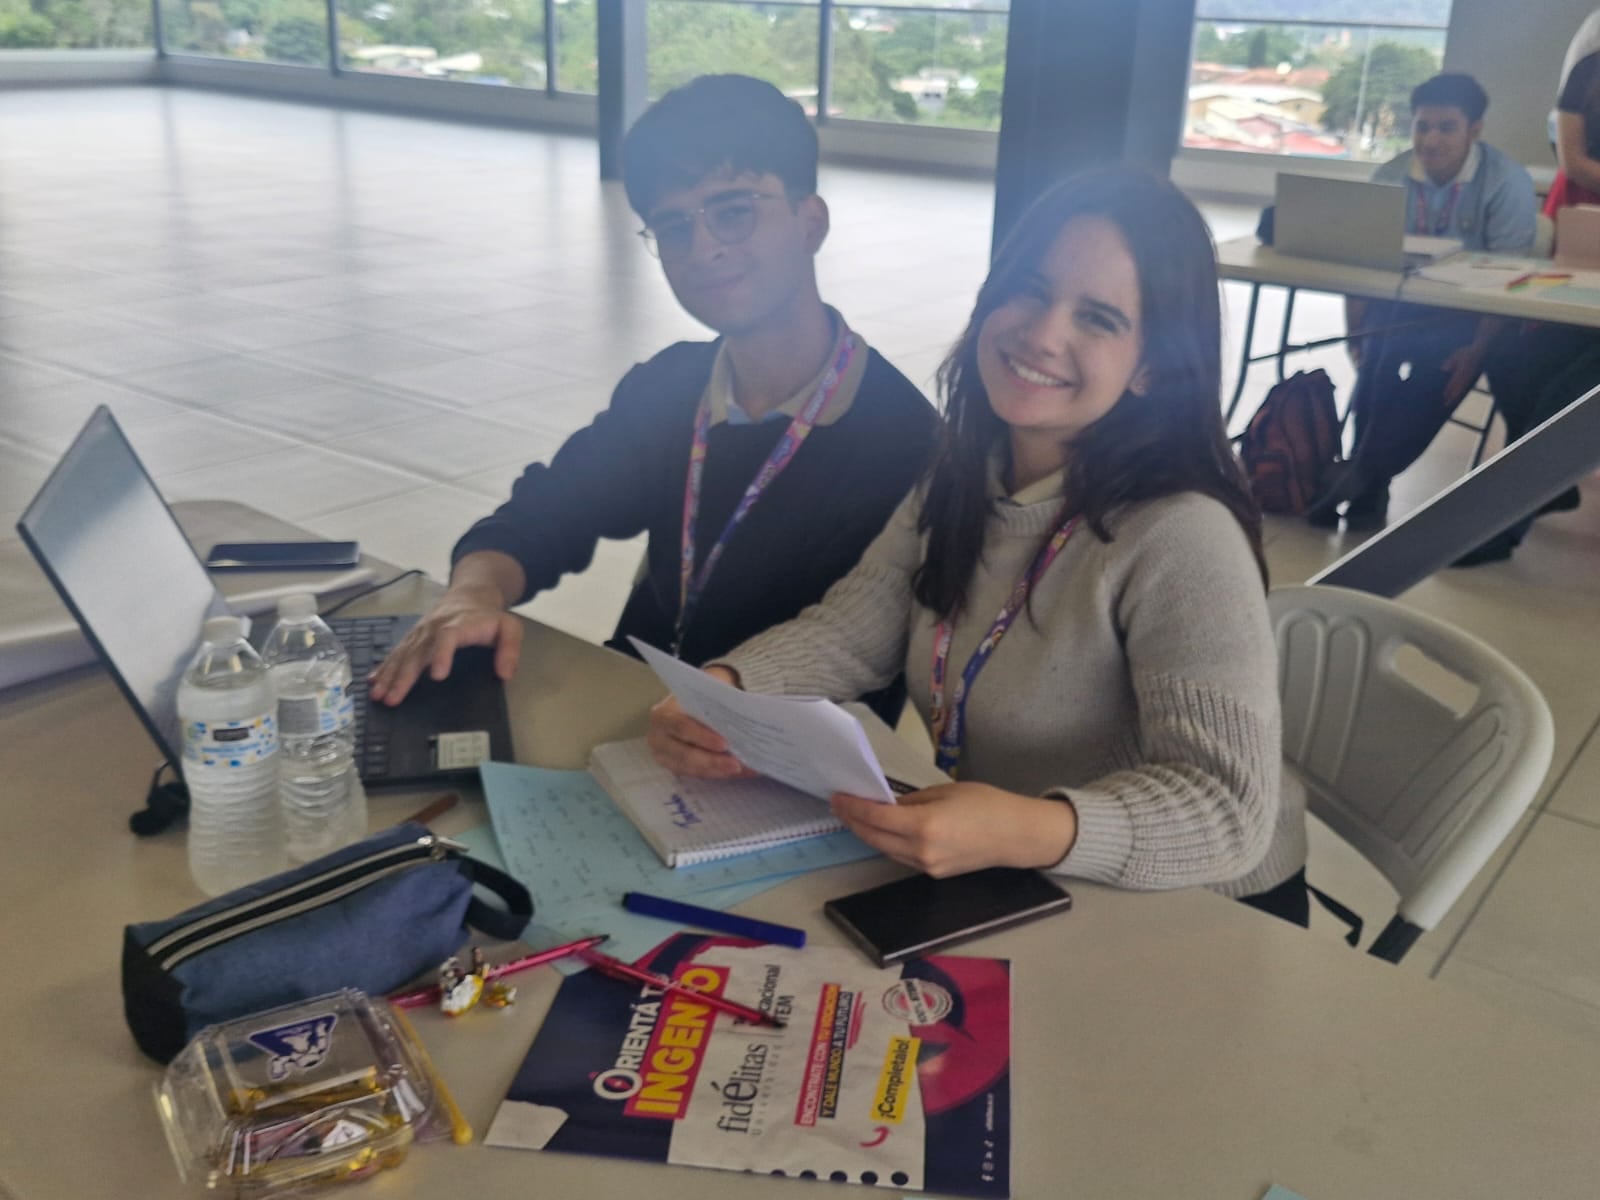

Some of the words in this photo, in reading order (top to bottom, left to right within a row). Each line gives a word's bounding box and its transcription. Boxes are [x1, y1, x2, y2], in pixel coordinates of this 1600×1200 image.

[593, 1001, 662, 1100] ORIENTÁ
[634, 967, 720, 1114] INGENO
[832, 1039, 844, 1048] A
[833, 1025, 847, 1039] TU
[710, 1043, 768, 1134] fidélitas
[801, 1063, 825, 1124] ENCONTRATE
[814, 1042, 828, 1061] CON
[828, 1049, 843, 1080] MUNDO
[823, 1083, 838, 1108] DALE
